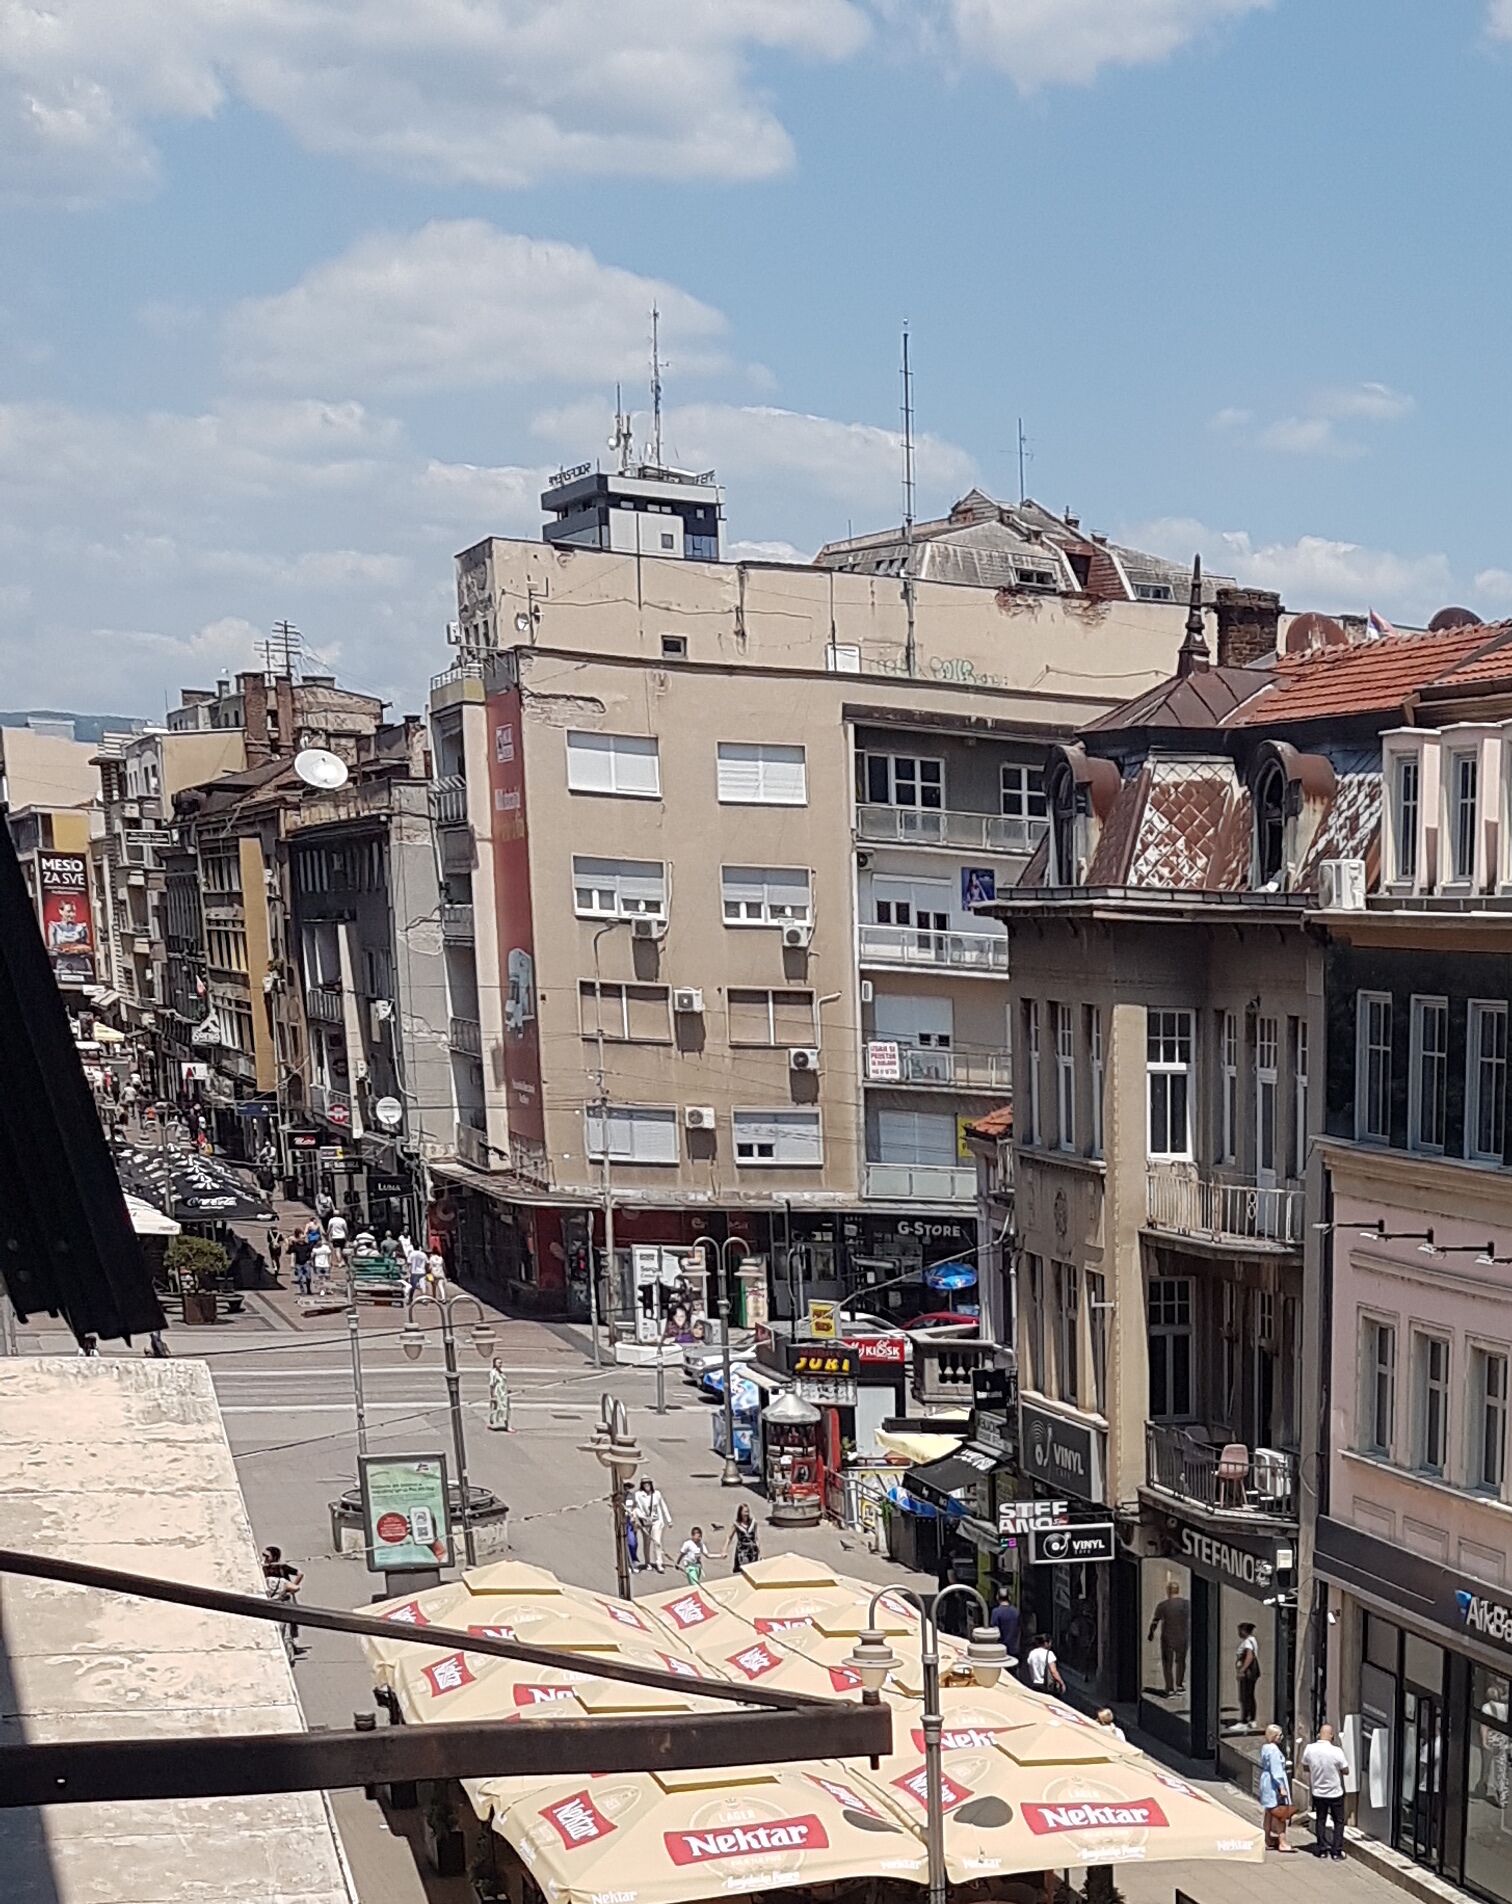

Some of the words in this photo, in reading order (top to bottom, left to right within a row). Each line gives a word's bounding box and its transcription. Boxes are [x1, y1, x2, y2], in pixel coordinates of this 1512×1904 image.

[43, 871, 61, 884] ZA
[62, 872, 86, 886] SVE
[1053, 1443, 1085, 1475] VINYL
[1072, 1539, 1106, 1550] VINYL
[1181, 1527, 1255, 1584] STEFANO
[1038, 1803, 1150, 1829] Nektar
[681, 1823, 808, 1858] Nektar
